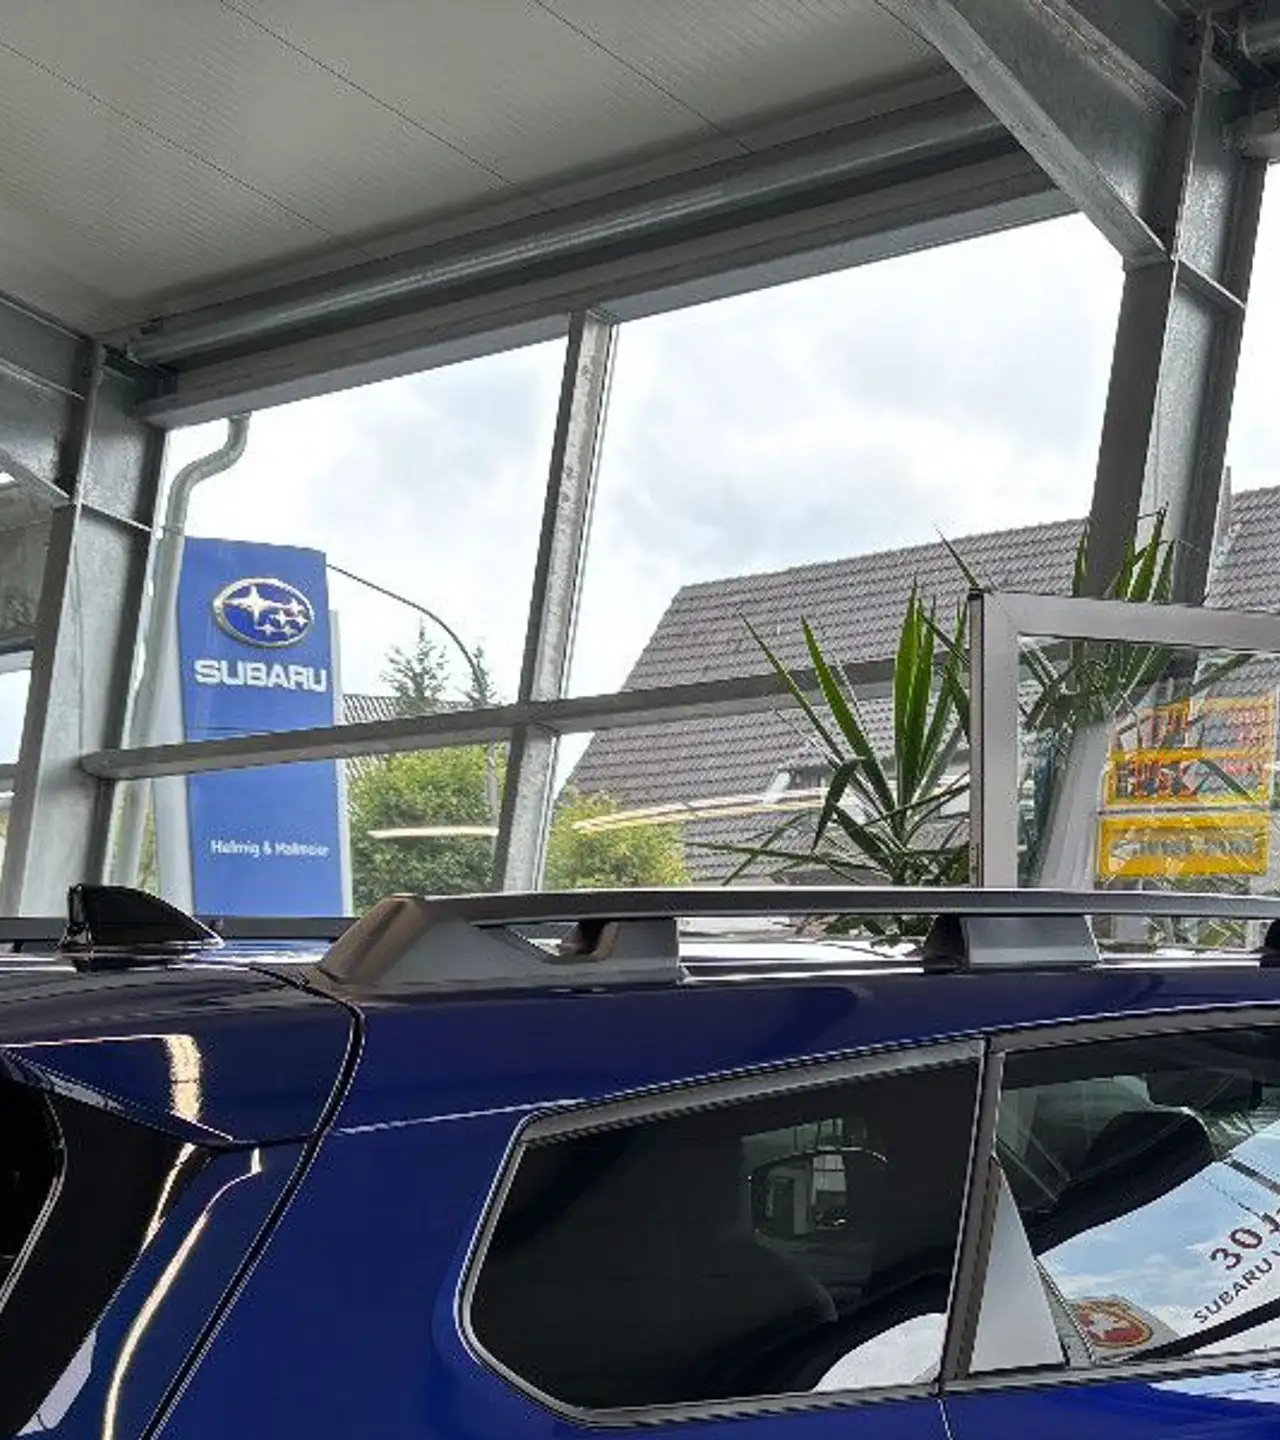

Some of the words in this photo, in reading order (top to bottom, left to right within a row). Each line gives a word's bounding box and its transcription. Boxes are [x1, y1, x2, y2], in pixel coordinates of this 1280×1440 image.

[195, 659, 327, 692] SUBARU
[1210, 1227, 1263, 1270] 30
[1193, 1258, 1273, 1323] SUBARU
